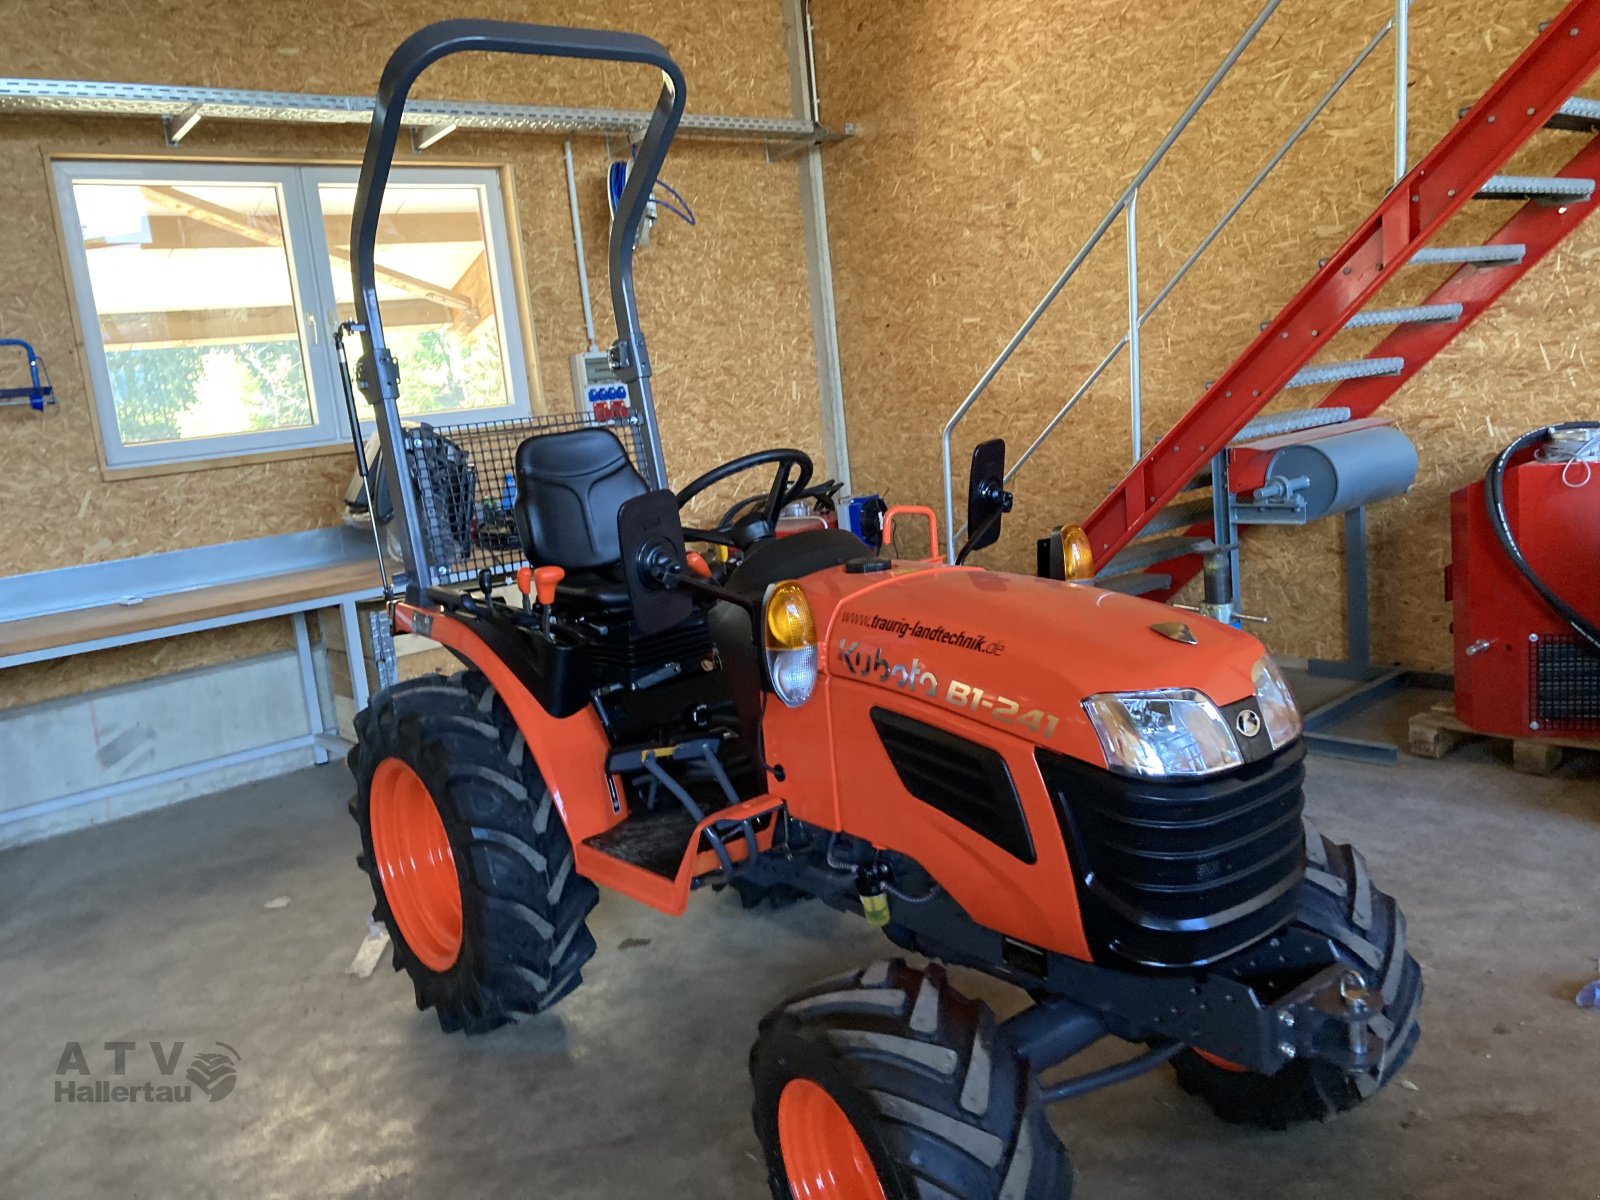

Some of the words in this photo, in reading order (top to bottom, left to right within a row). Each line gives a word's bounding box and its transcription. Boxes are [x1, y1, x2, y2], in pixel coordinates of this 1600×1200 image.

[841, 611, 1005, 656] www.traurig-landtechnik.de
[838, 638, 938, 697] Kubota
[946, 680, 1060, 738] B1-241
